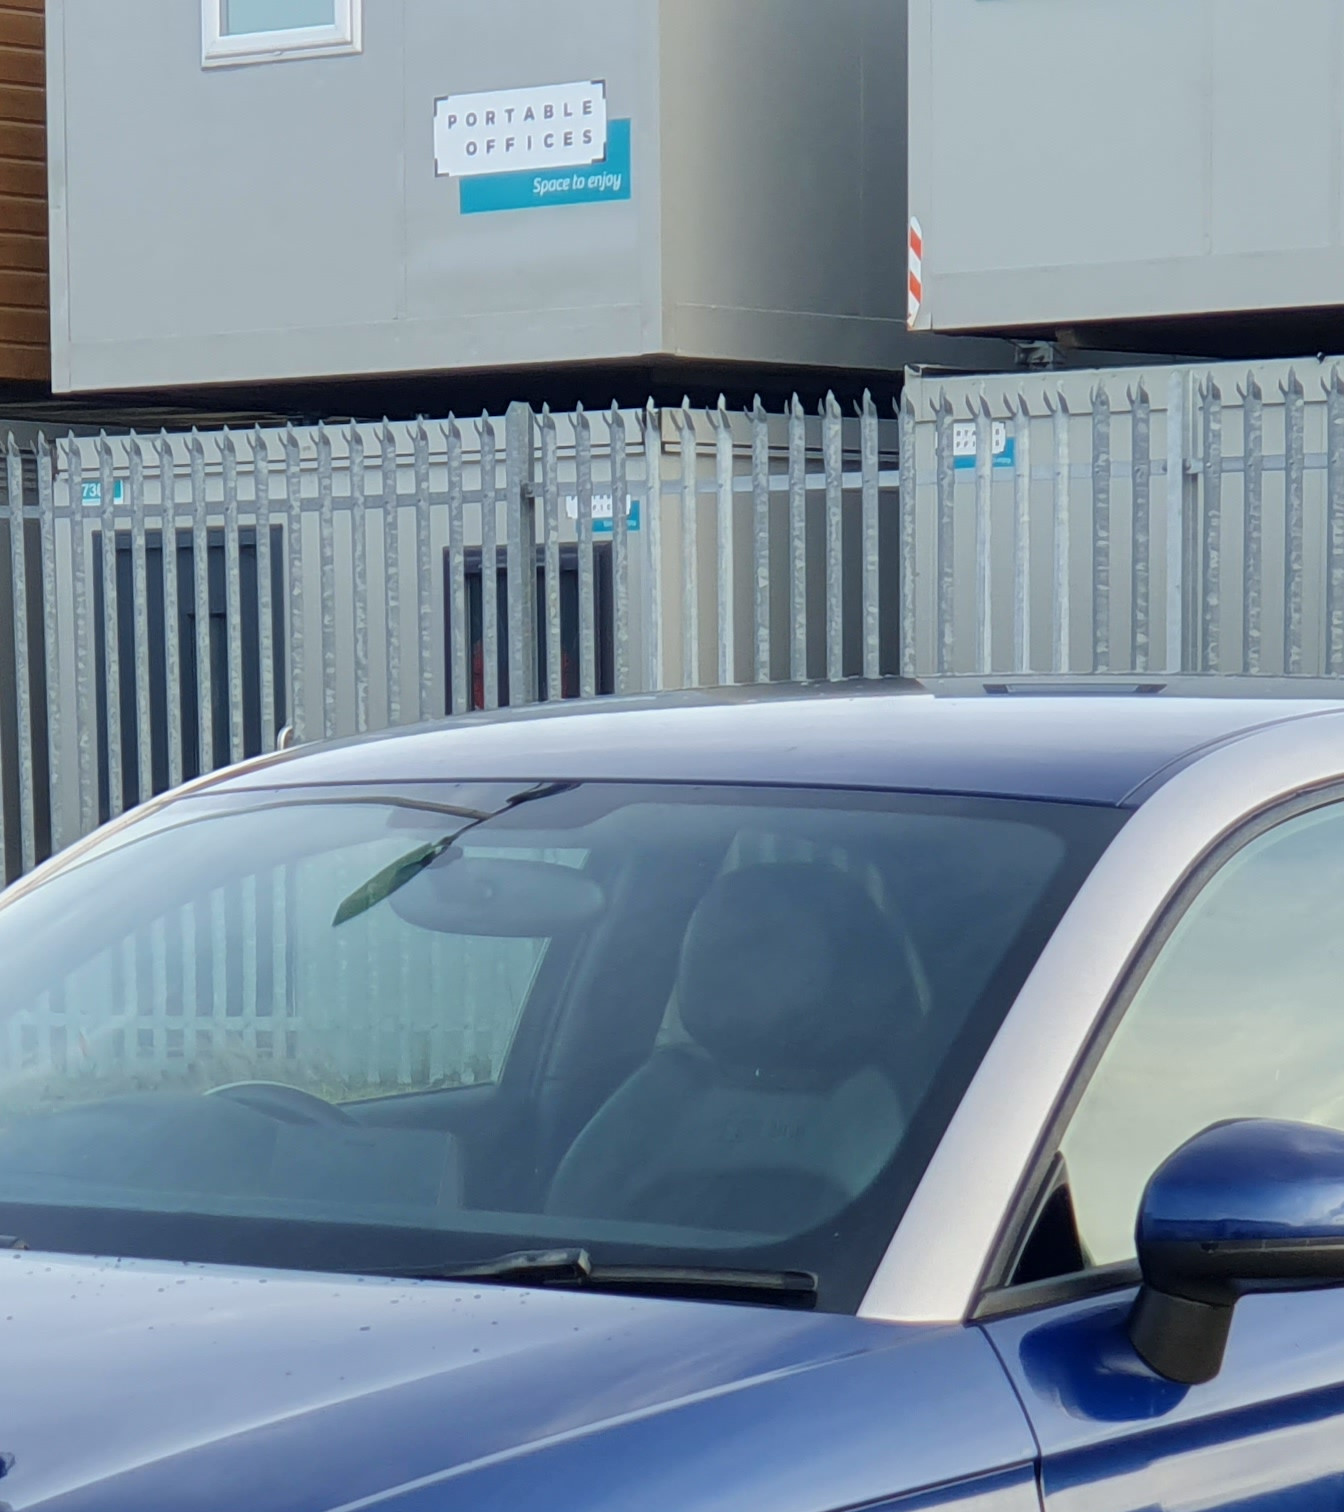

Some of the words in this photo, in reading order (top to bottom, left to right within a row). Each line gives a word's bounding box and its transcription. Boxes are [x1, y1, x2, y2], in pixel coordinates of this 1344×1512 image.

[448, 100, 593, 130] PORTABLE
[465, 129, 593, 156] OFFICES
[532, 175, 569, 196] Space
[572, 173, 585, 190] to
[587, 171, 622, 191] enjoy
